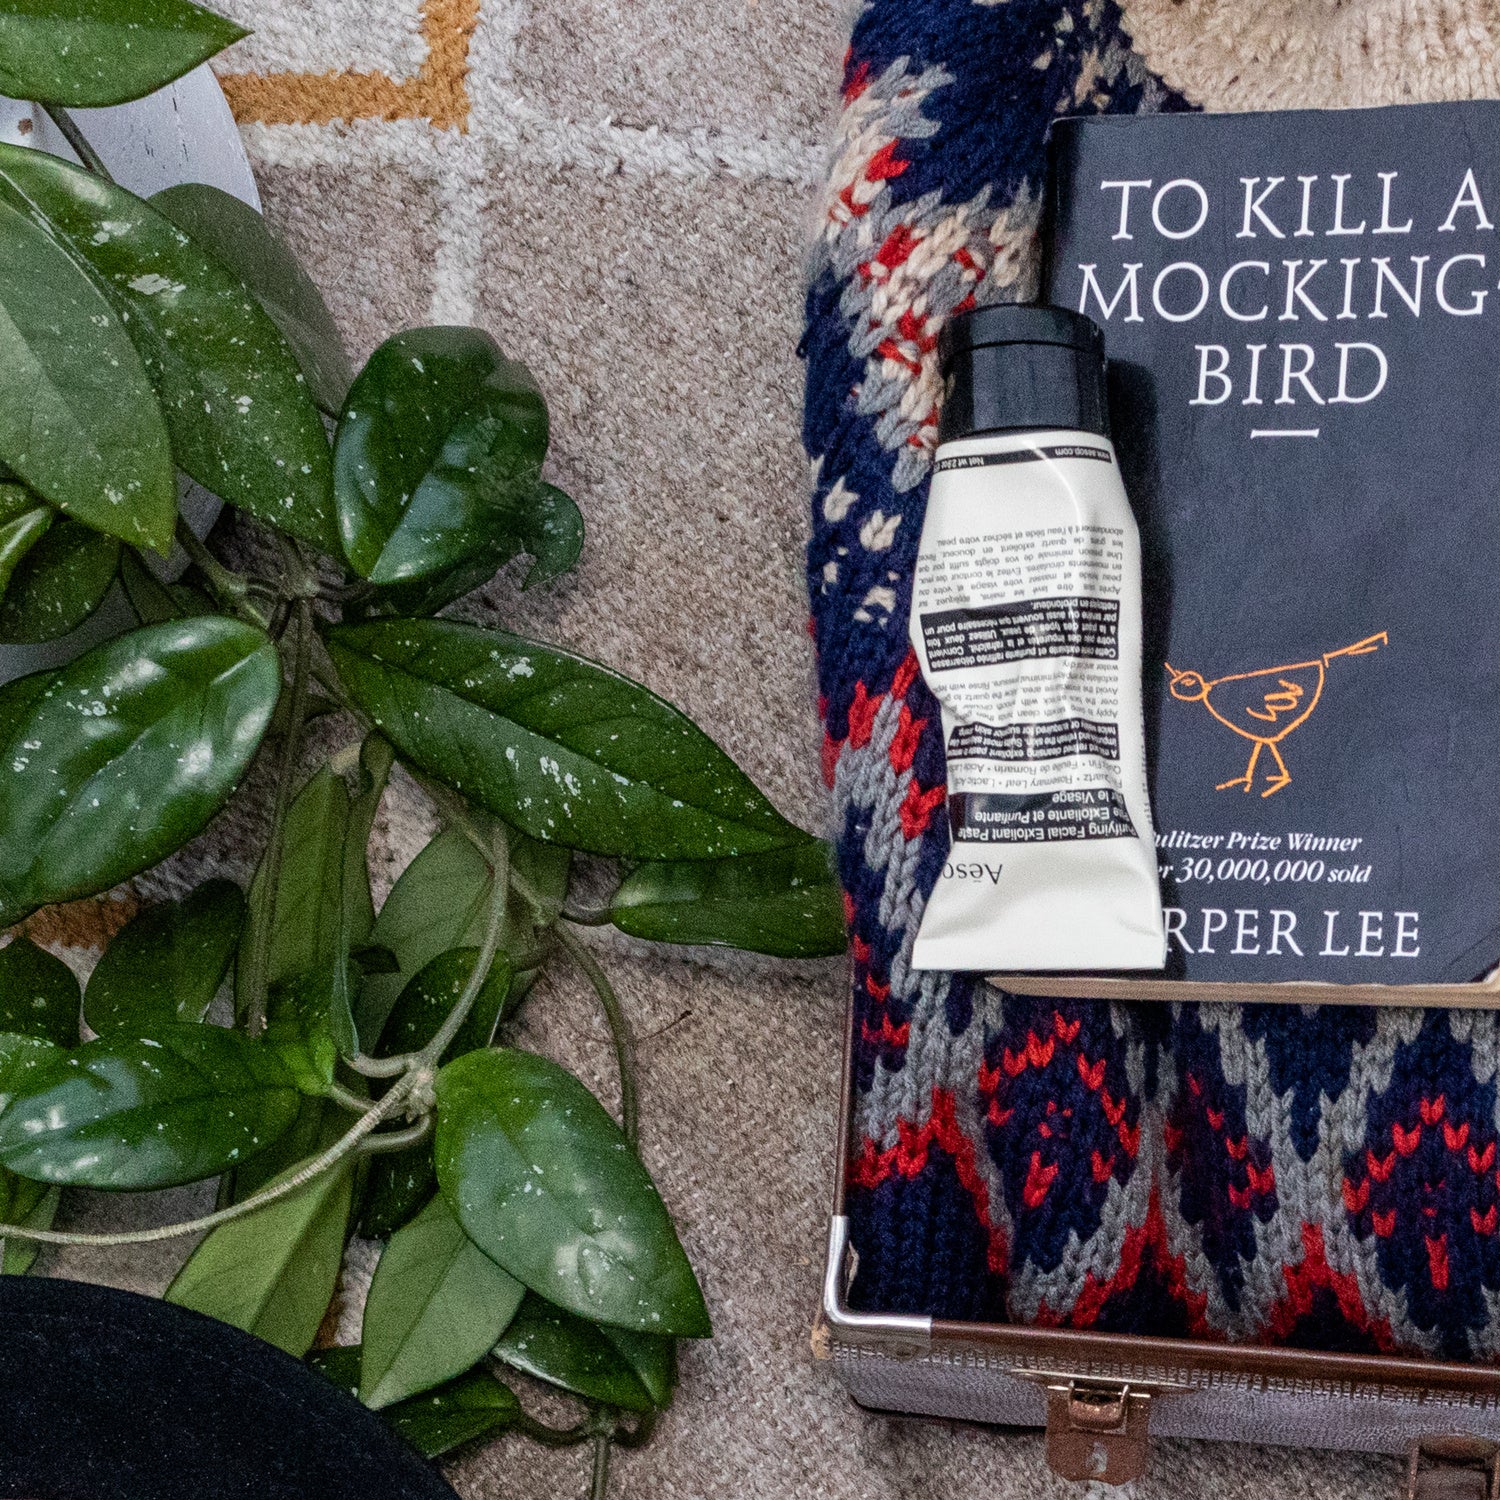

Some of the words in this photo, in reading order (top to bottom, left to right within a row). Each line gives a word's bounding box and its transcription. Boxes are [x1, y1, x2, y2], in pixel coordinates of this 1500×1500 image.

[1100, 178, 1209, 241] TO
[1235, 171, 1414, 239] KILL
[1437, 168, 1495, 232] A
[1188, 341, 1389, 406] BIRD
[1052, 790, 1095, 804] Visage
[1098, 791, 1109, 802] le
[974, 811, 1030, 824] Purifiante
[1033, 811, 1045, 823] et
[1047, 807, 1110, 822] Exfoliante
[958, 827, 989, 841] Paste
[991, 827, 1045, 841] Exfoliant
[1048, 826, 1086, 839] Facial
[1154, 830, 1224, 850] ulitzer
[1226, 831, 1282, 851] Prize
[1287, 832, 1363, 852] Winner
[943, 863, 1003, 885] Aēso
[1175, 857, 1325, 887] 30,000,000
[1327, 865, 1372, 884] sold
[1162, 907, 1304, 957] RPER
[1319, 909, 1420, 959] LEE
